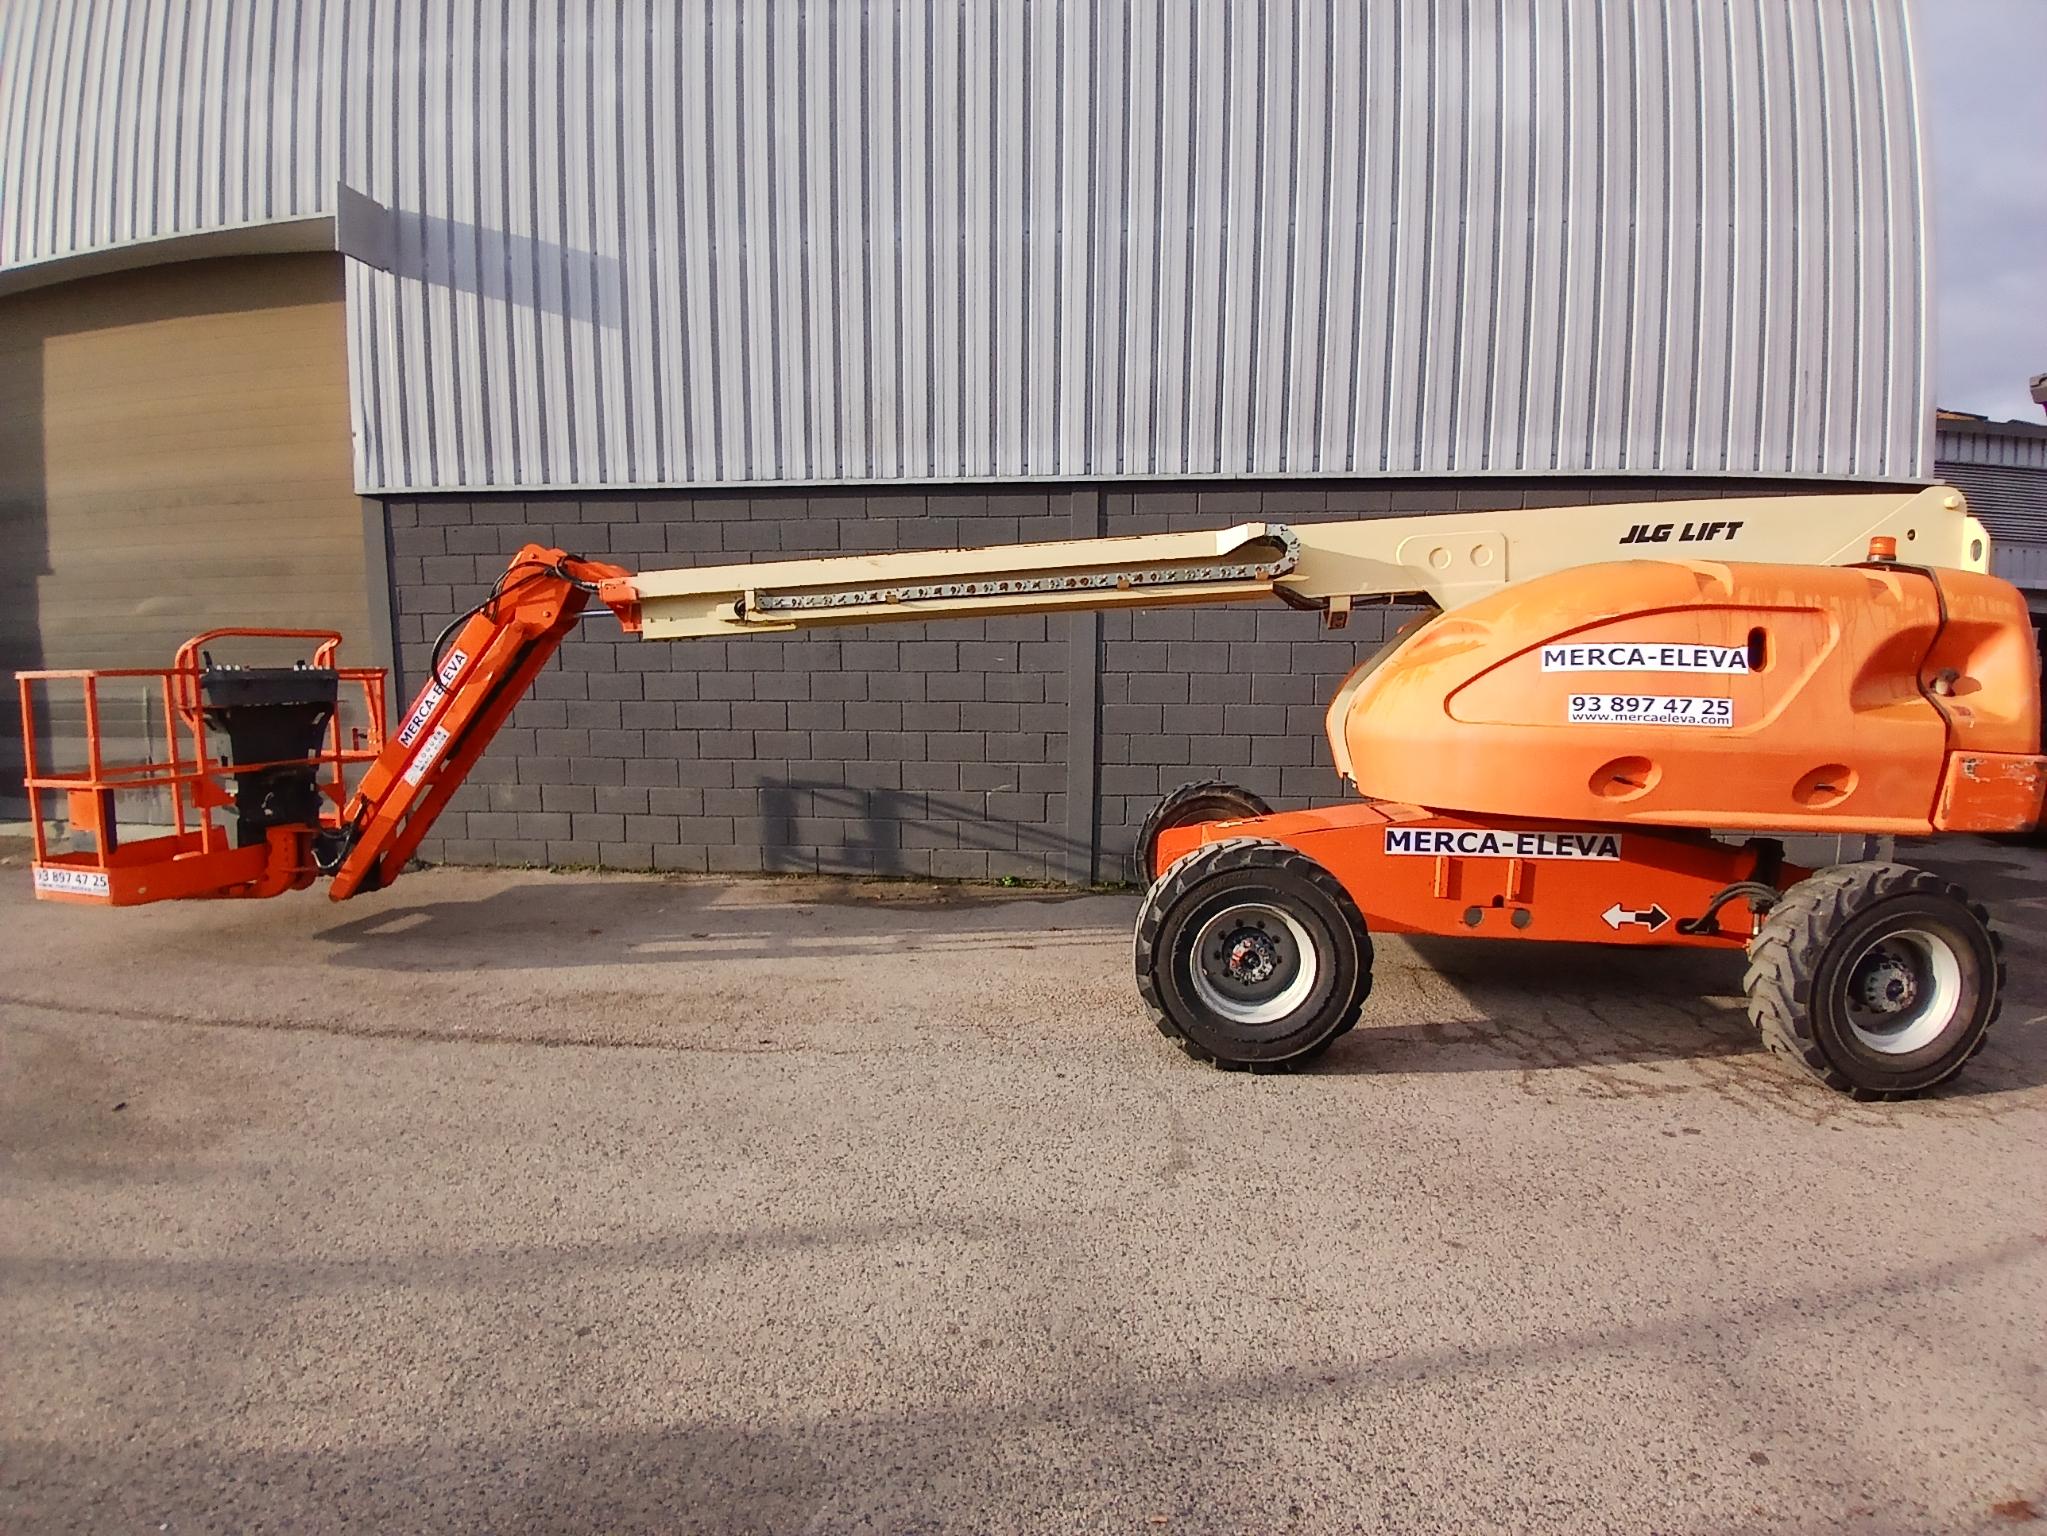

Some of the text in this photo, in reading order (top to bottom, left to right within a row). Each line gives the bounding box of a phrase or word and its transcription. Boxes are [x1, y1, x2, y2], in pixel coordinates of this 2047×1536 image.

[1619, 521, 1744, 545] JLG LIFT
[1544, 647, 1747, 669] MERCA-ELEVA
[400, 653, 465, 746] MERCA-ELEVA
[1571, 696, 1730, 716] 93 897 47 25
[1572, 713, 1730, 725] www.mercaeleva.com
[1386, 830, 1620, 858] MERCA-ELEVA
[52, 871, 71, 884] 897
[75, 873, 88, 885] 47
[93, 875, 107, 888] 25
